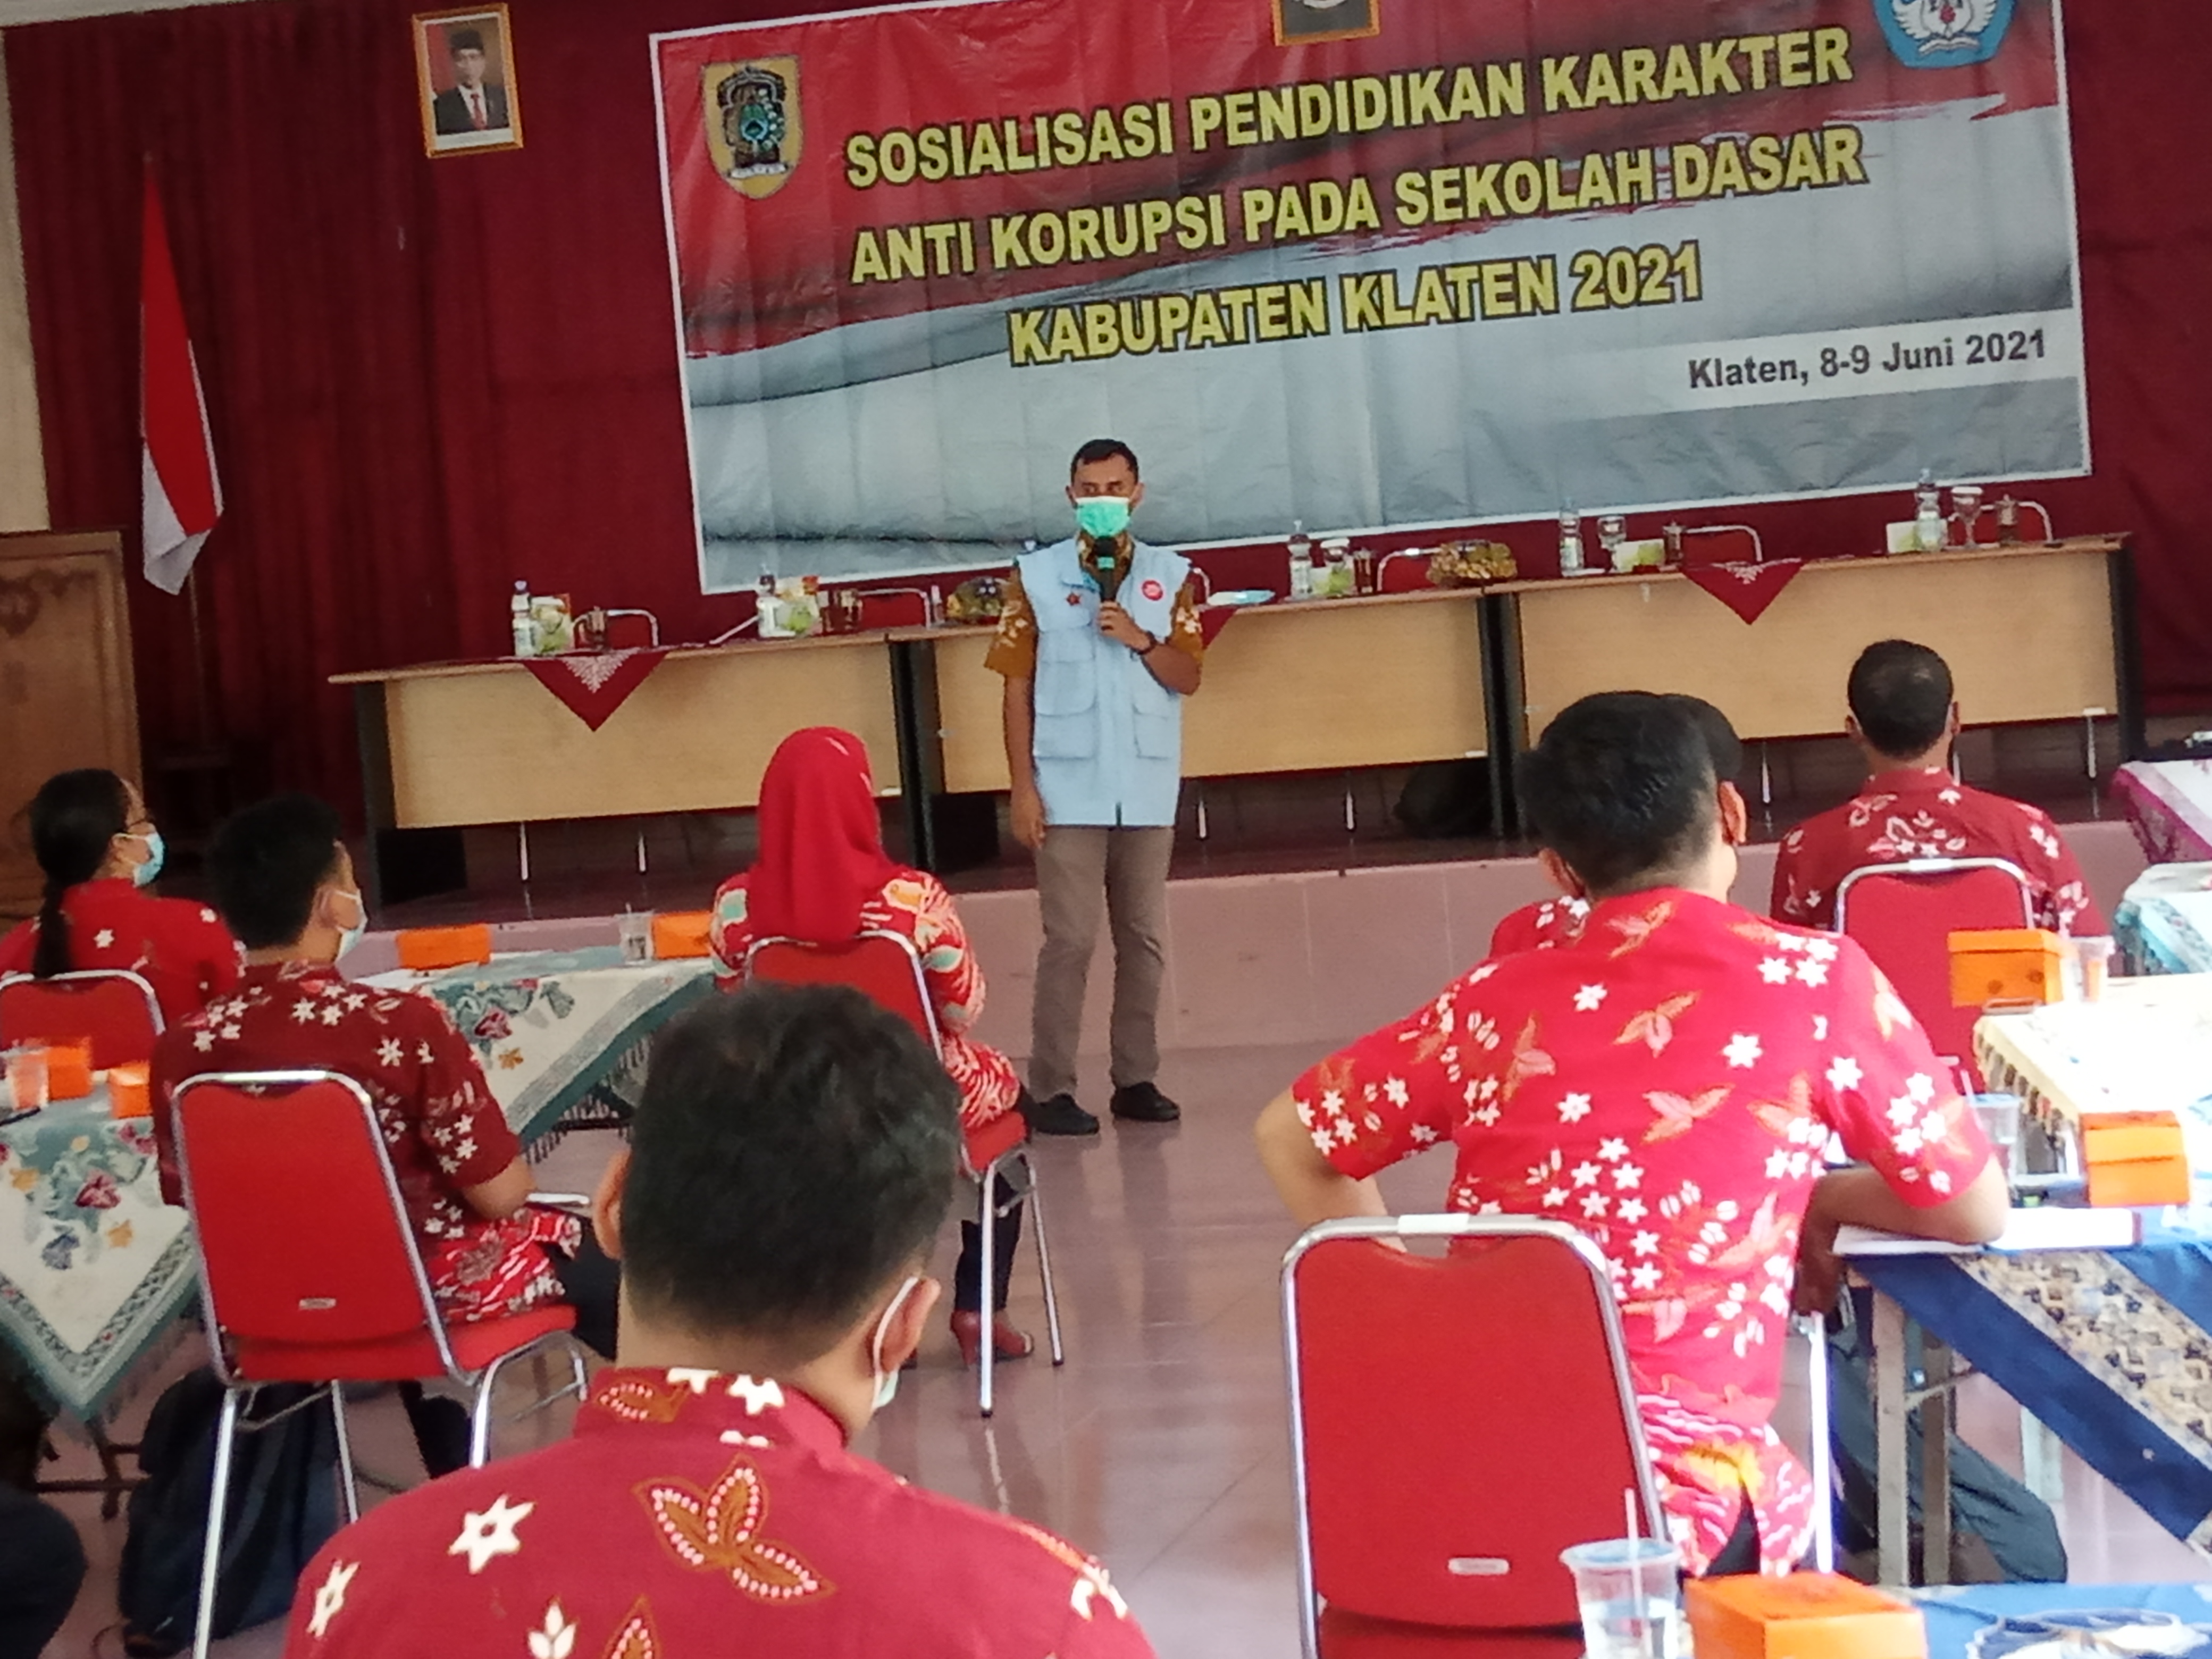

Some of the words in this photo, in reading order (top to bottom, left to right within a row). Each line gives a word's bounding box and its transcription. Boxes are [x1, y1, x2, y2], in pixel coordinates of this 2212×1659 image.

[846, 100, 1174, 189] SOSIALISASI
[1189, 61, 1526, 152] PENDIDIKAN
[1541, 25, 1854, 113] KARAKTER
[850, 220, 977, 284] ANTI
[988, 192, 1226, 269] KORUPSI
[1242, 176, 1381, 242] PADA
[1394, 147, 1655, 227] SEKOLAH
[1670, 124, 1870, 199] DASAR
[1008, 276, 1329, 366] KABUPATEN
[1339, 254, 1559, 333] KLATEN
[1569, 239, 1703, 313] 2021
[1688, 356, 1809, 389] Klaten,
[1820, 345, 1870, 377] 8-9
[1882, 337, 1954, 372] Juni
[1965, 328, 2046, 366] 2021
